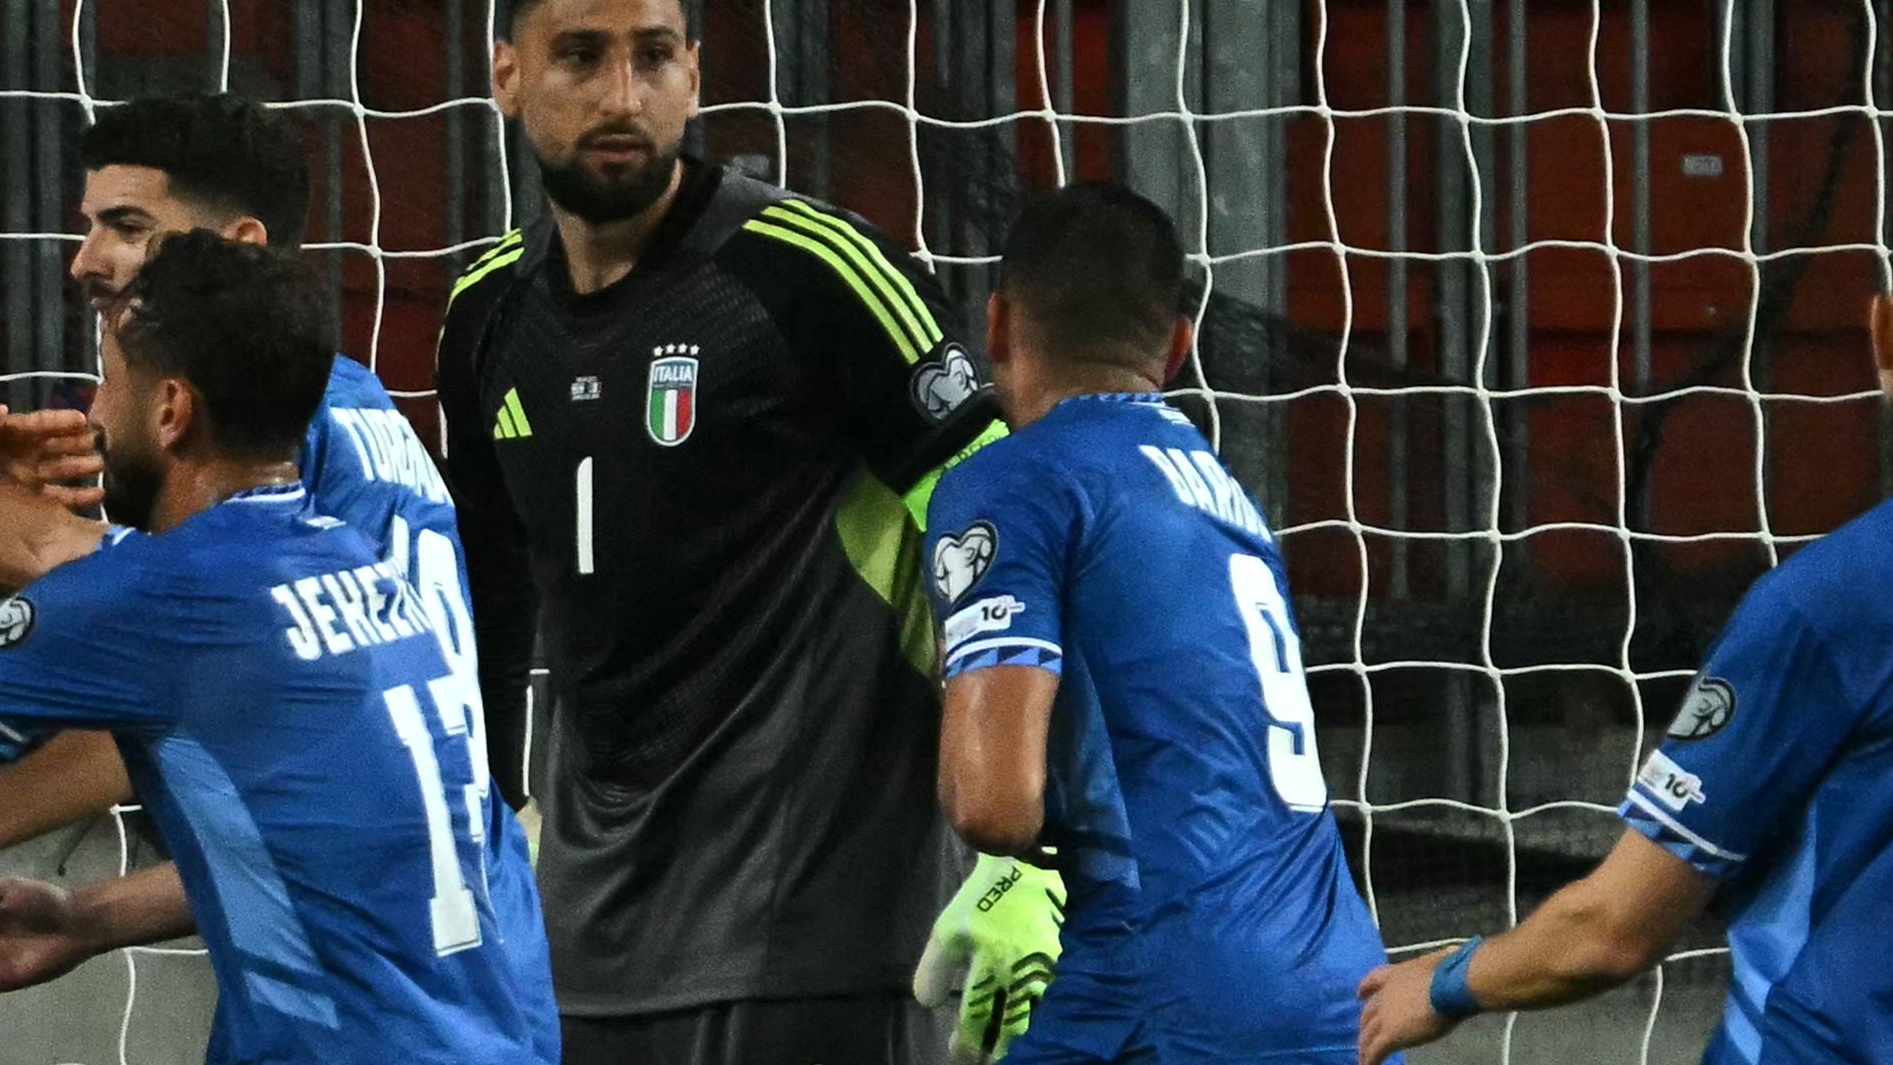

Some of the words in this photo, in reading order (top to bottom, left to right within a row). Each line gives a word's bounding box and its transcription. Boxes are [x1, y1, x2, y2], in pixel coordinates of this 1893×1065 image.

[653, 364, 694, 383] ITALIA
[576, 455, 594, 575] 1
[1229, 552, 1328, 813] 9
[976, 865, 1023, 913] PRED
